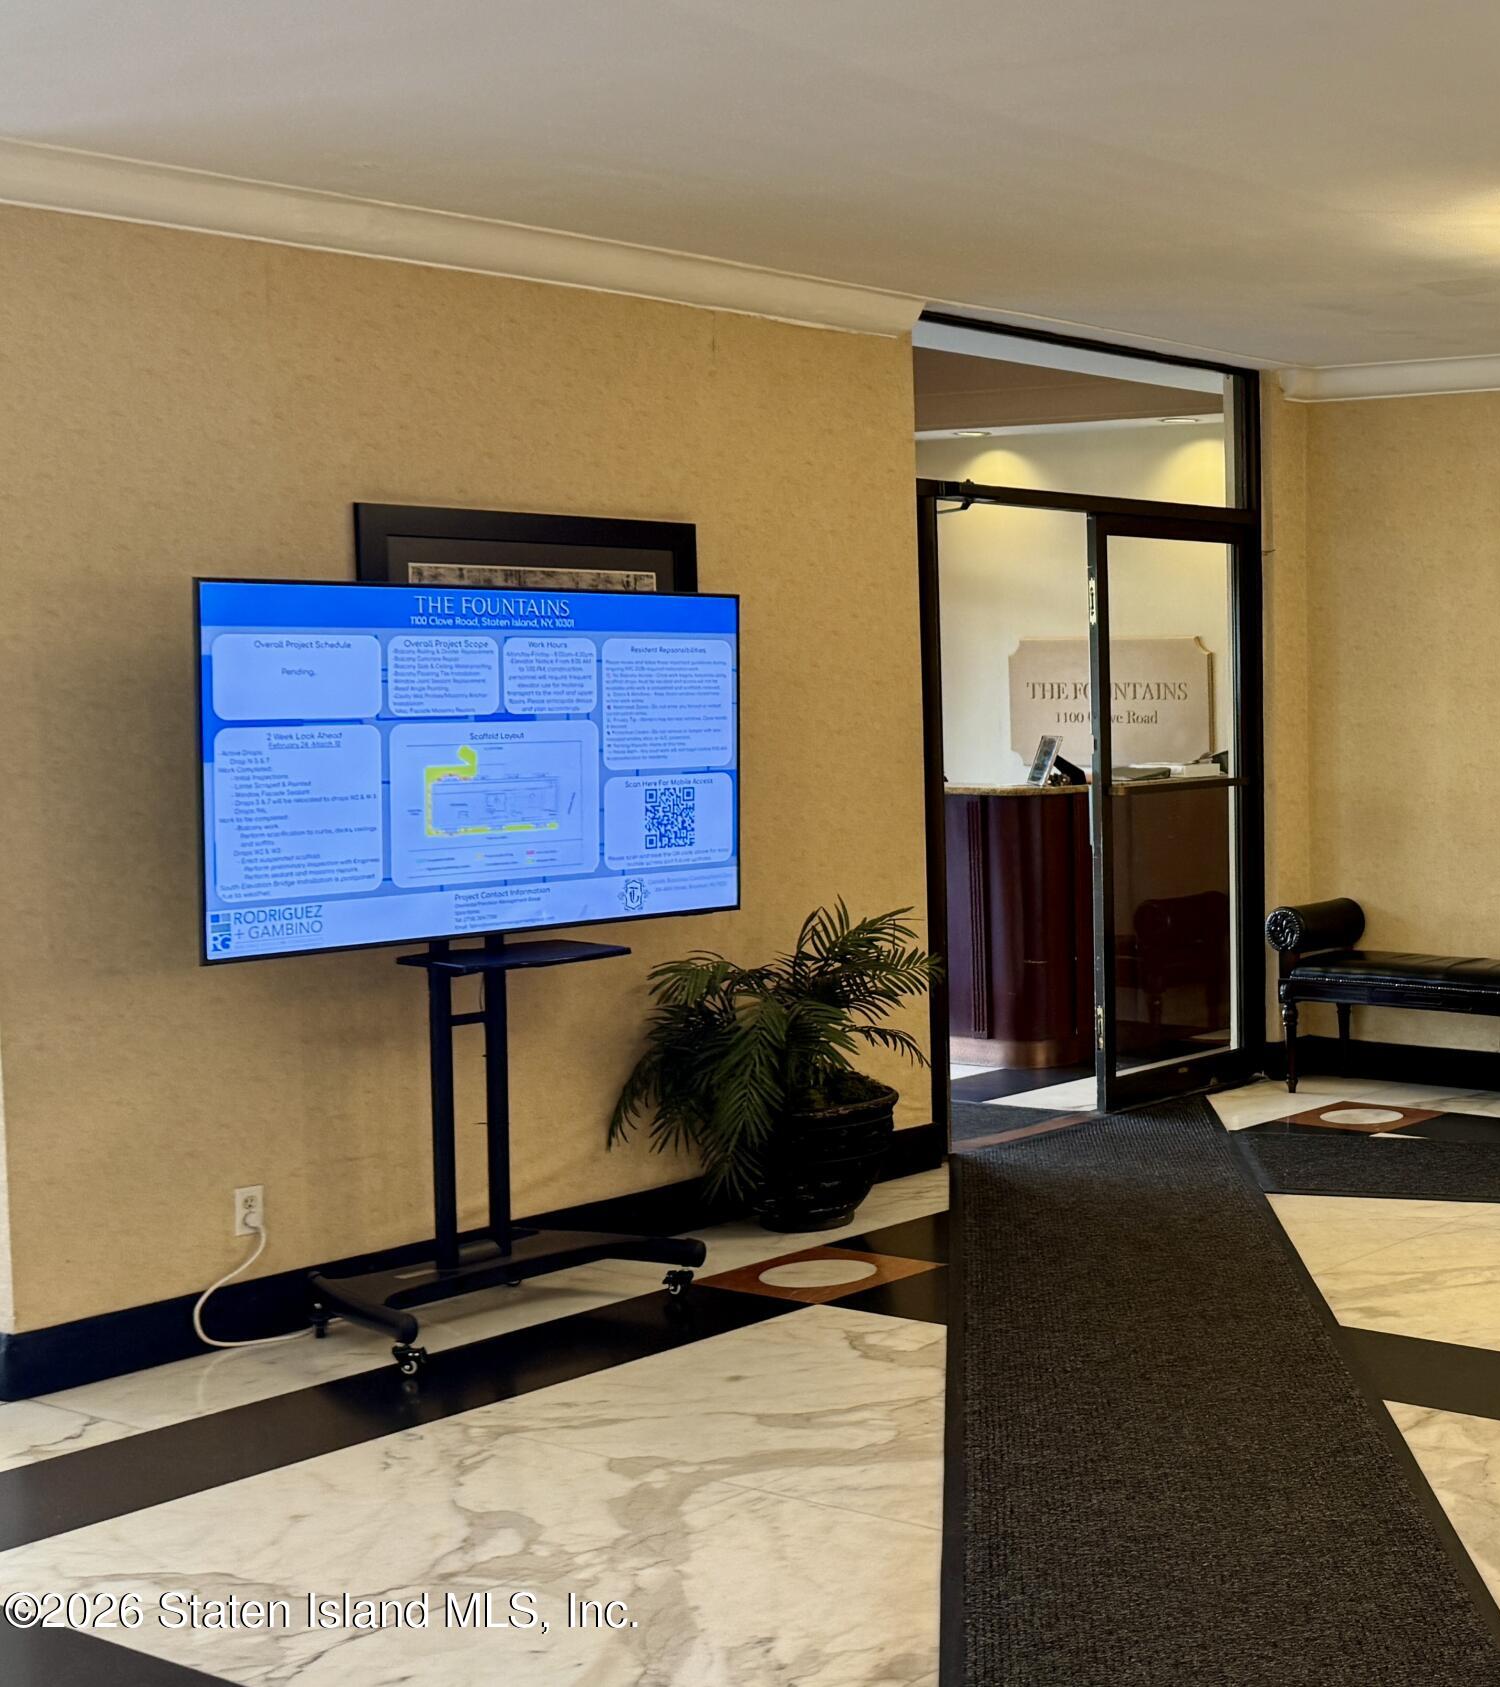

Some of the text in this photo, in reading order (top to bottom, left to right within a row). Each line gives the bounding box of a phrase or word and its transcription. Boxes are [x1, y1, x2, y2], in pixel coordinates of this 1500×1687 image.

[413, 595, 571, 617] THE FOUNTAINS
[409, 615, 428, 626] 1100
[428, 615, 454, 627] Clove
[455, 616, 480, 628] Road,
[482, 616, 510, 628] Staten
[511, 617, 540, 629] Island,
[555, 618, 575, 629] 10301
[253, 640, 352, 651] Overall Project Schedule
[403, 639, 489, 650] Overall Project Scope
[528, 641, 568, 649] Work Hours
[1026, 681, 1188, 700] THE FNTAINS
[1055, 711, 1085, 724] 1100
[1126, 710, 1158, 724] Road
[266, 731, 342, 741] 2 Week Look Ahead
[469, 731, 525, 742] Scaffold Layout
[624, 780, 641, 788] Scan
[642, 780, 657, 788] Here
[670, 778, 692, 786] Mobile
[692, 777, 713, 785] Access
[454, 893, 479, 902] Project
[480, 890, 509, 899] Contact
[510, 887, 551, 896] Information
[233, 904, 323, 926] RODRIGUEZ
[247, 919, 324, 940] GAMBINO
